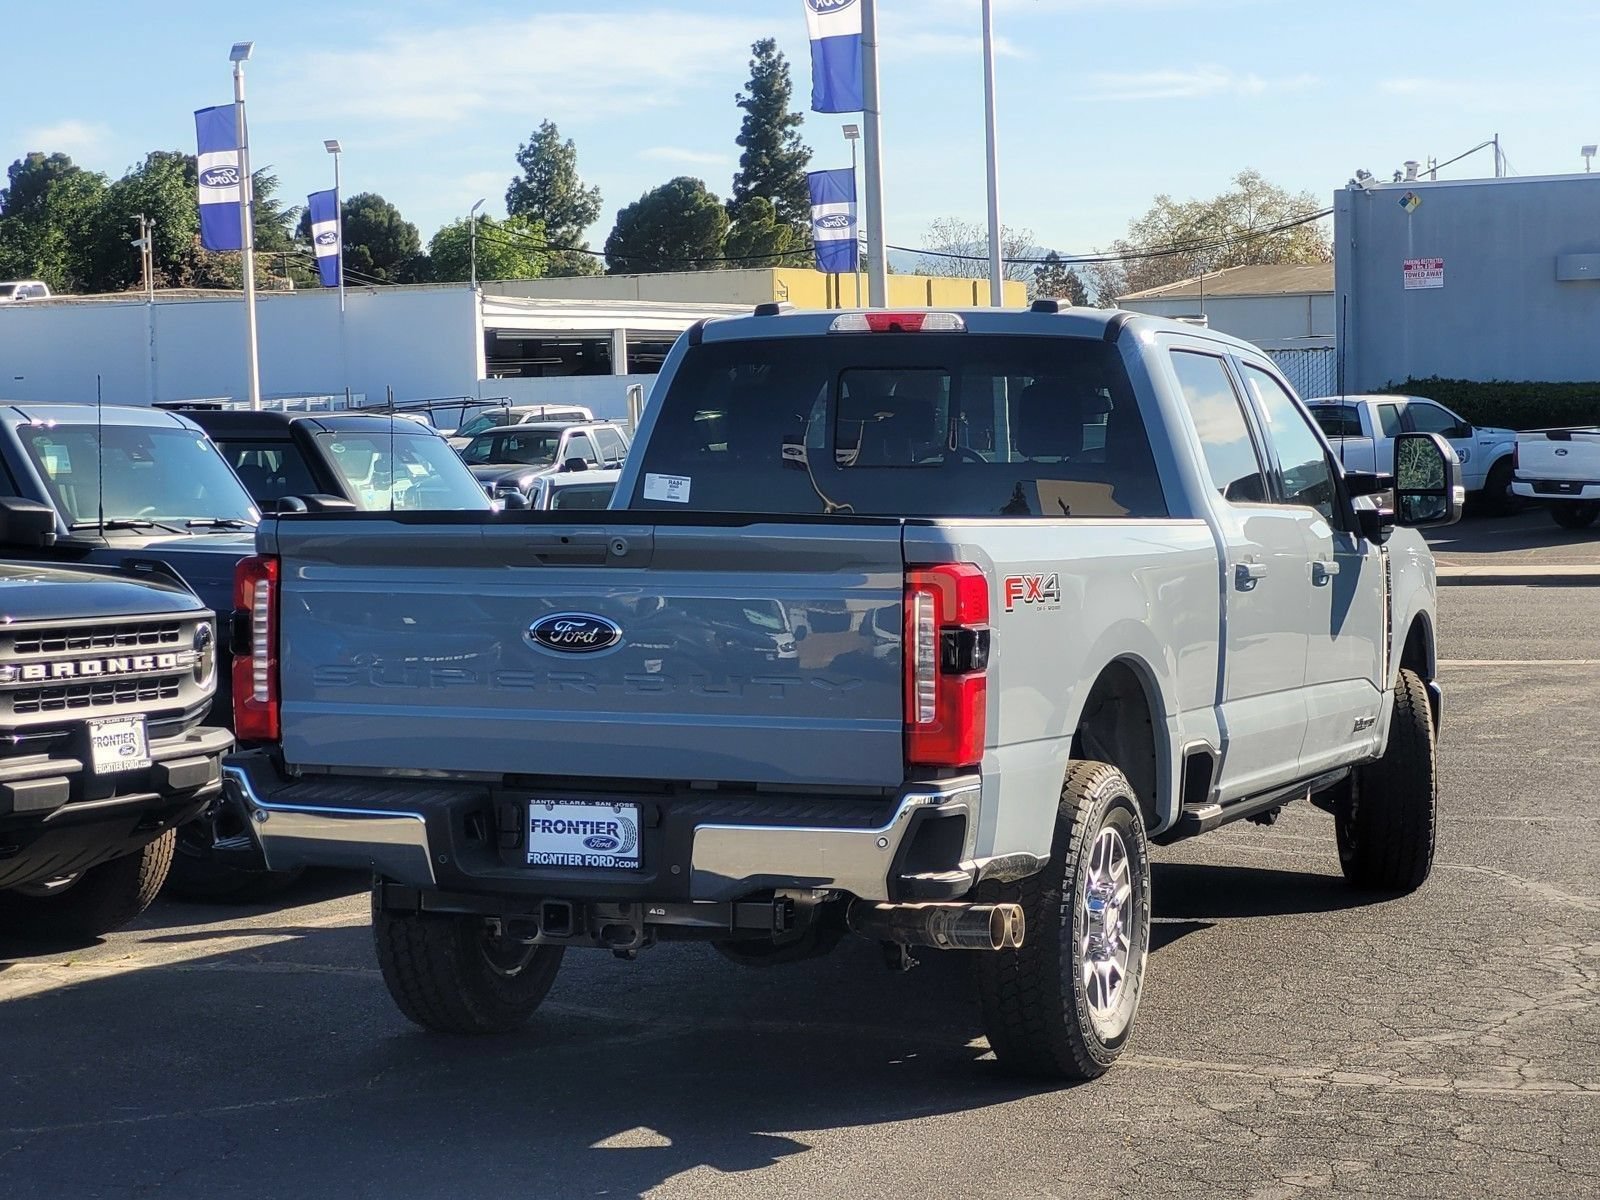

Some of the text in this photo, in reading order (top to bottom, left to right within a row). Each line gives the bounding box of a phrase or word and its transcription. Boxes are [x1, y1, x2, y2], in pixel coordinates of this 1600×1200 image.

[1004, 574, 1060, 612] FX4
[550, 620, 598, 643] Ford
[22, 653, 177, 679] BRONCO
[313, 664, 862, 700] SUPER DUTY
[92, 733, 136, 748] FRONTIER
[531, 818, 621, 841] FRONTIER
[590, 838, 612, 849] Ford
[527, 852, 583, 867] FRONTIER
